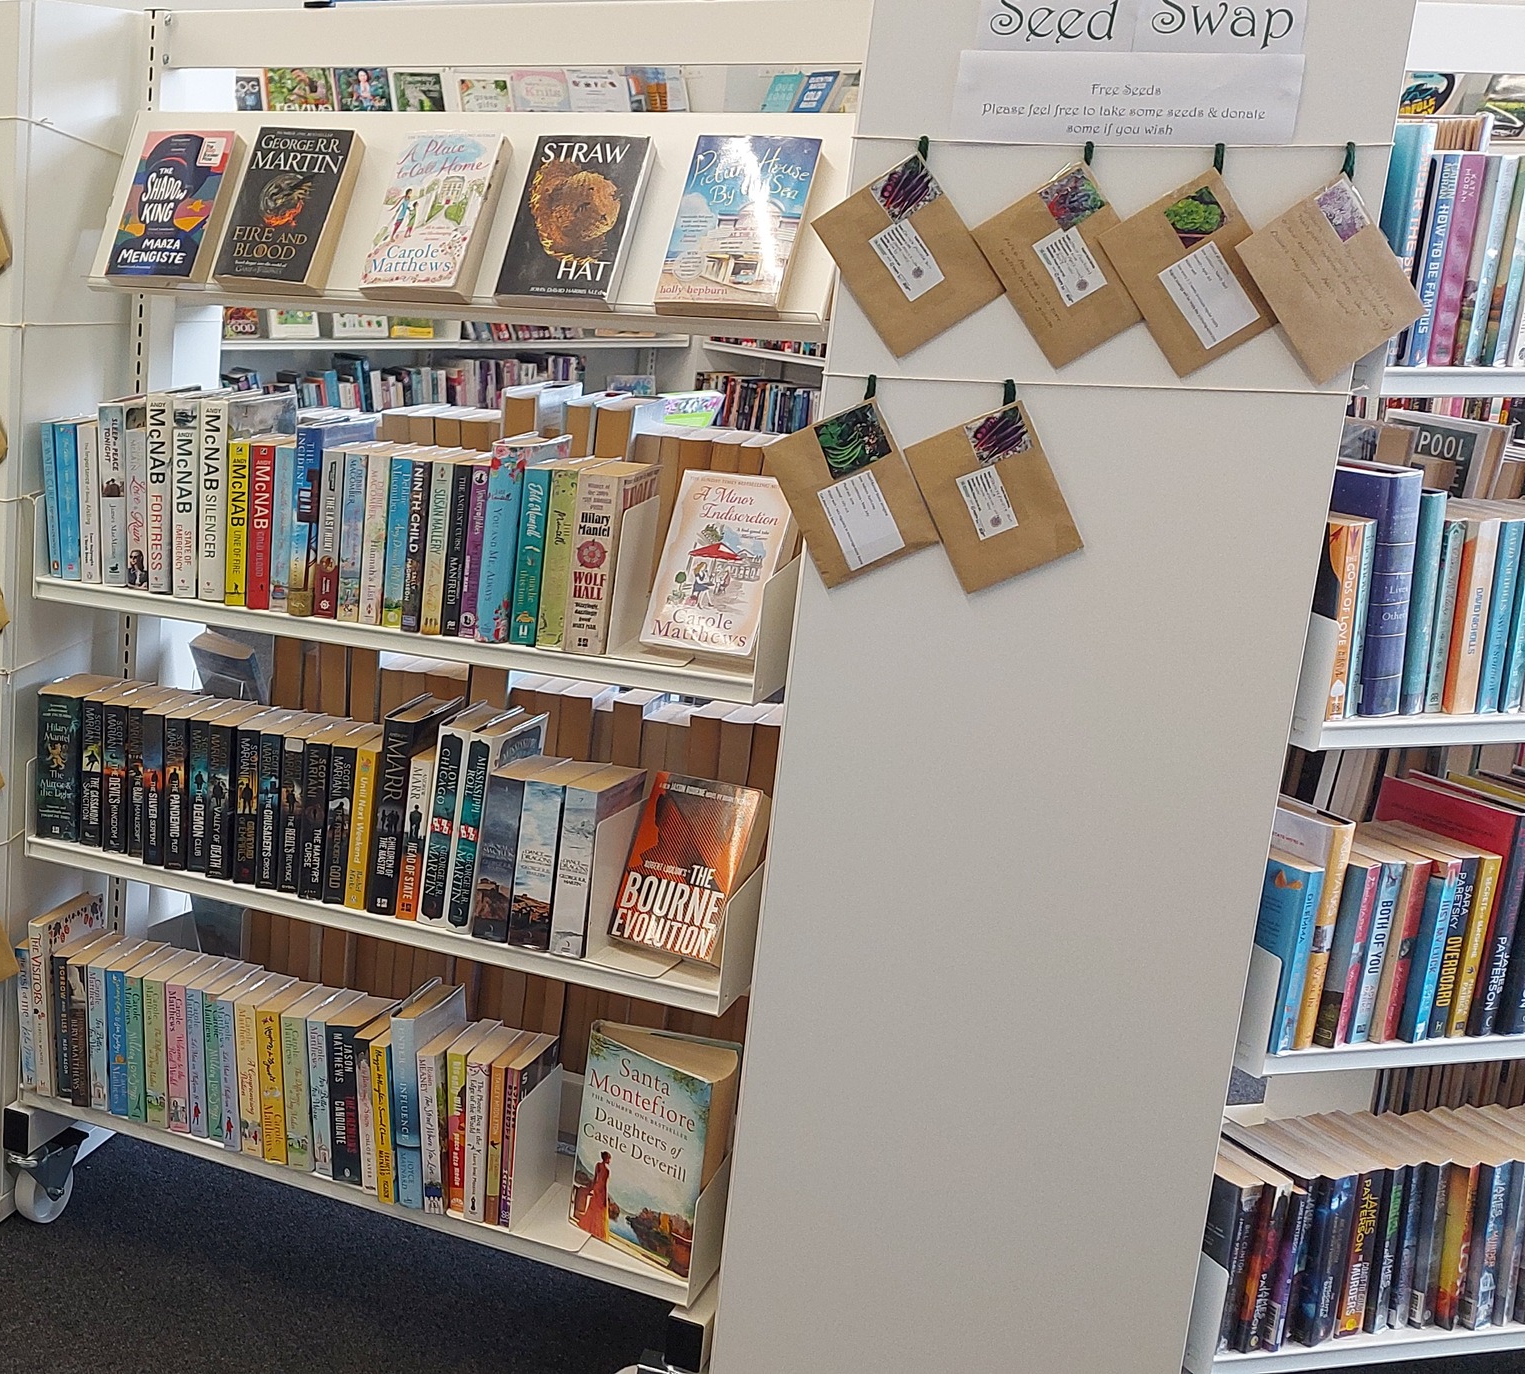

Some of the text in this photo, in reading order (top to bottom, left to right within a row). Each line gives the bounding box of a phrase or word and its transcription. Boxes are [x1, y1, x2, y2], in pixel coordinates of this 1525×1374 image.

[989, 0, 1294, 50] Seed Swap
[1091, 83, 1162, 97] Free Seeds
[981, 102, 1266, 120] Please feel free to take some seeds & donate
[261, 134, 315, 152] GEORGE
[1065, 122, 1174, 138] some if you wish
[250, 151, 344, 175] MARTIN
[421, 139, 466, 161] Place
[540, 142, 630, 165] STRAW
[158, 166, 174, 175] THE
[409, 156, 490, 178] Call Home
[141, 172, 188, 201] SHADOW
[141, 202, 174, 225] KING
[141, 237, 181, 250] MAAZA
[232, 225, 308, 245] FIRE AND
[117, 248, 187, 265] MENGISTE
[232, 242, 296, 260] BLOOD
[372, 256, 452, 272] Matthews
[387, 244, 439, 258] Carole
[556, 260, 612, 282] HAT
[659, 284, 728, 298] holly hepburn
[1417, 281, 1438, 335] FAMOUS
[297, 432, 307, 487] INCIDENT
[1419, 431, 1466, 461] POOL
[150, 408, 167, 572] McNAB FORTRESS
[176, 438, 193, 515] McNAB
[203, 413, 221, 561] McNAB SILENCER
[230, 463, 246, 528] McNAB
[254, 464, 271, 530] McNAB
[408, 463, 424, 554] NINTH CHILD
[714, 488, 755, 506] Minor
[580, 512, 611, 526] Hilary
[699, 503, 781, 527] Indiscretion
[577, 523, 611, 538] Mantel
[175, 523, 184, 573] EMERGENCY
[572, 585, 604, 601] HALL
[573, 571, 607, 587] WOLF
[651, 619, 748, 649] Matthews
[672, 608, 733, 631] Carole
[44, 731, 71, 743] Mantel
[46, 722, 70, 734] Hilary
[382, 737, 408, 802] MARR
[169, 794, 180, 839] PANDEMIC
[193, 803, 204, 838] DEMON
[353, 776, 369, 865] Until Weekend
[303, 842, 313, 869] CURSE
[689, 865, 716, 889] THE
[623, 873, 726, 929] BOURNE
[1449, 871, 1466, 929] PARETSKY
[611, 909, 716, 959] EVOLUTION
[1436, 936, 1462, 1008] OVERBOARD
[1485, 936, 1508, 1011] PATTERSON
[333, 1032, 344, 1084] MATTHEWS
[343, 1043, 354, 1073] JASON
[619, 1058, 671, 1098] Santa
[399, 1082, 410, 1142] INFLUENCE
[588, 1068, 696, 1133] Montefiore
[594, 1106, 668, 1153] Daughters
[583, 1122, 687, 1183] Castle Deverill
[1354, 1178, 1373, 1254] PATTERSON
[1345, 1262, 1362, 1318] MURDERS
